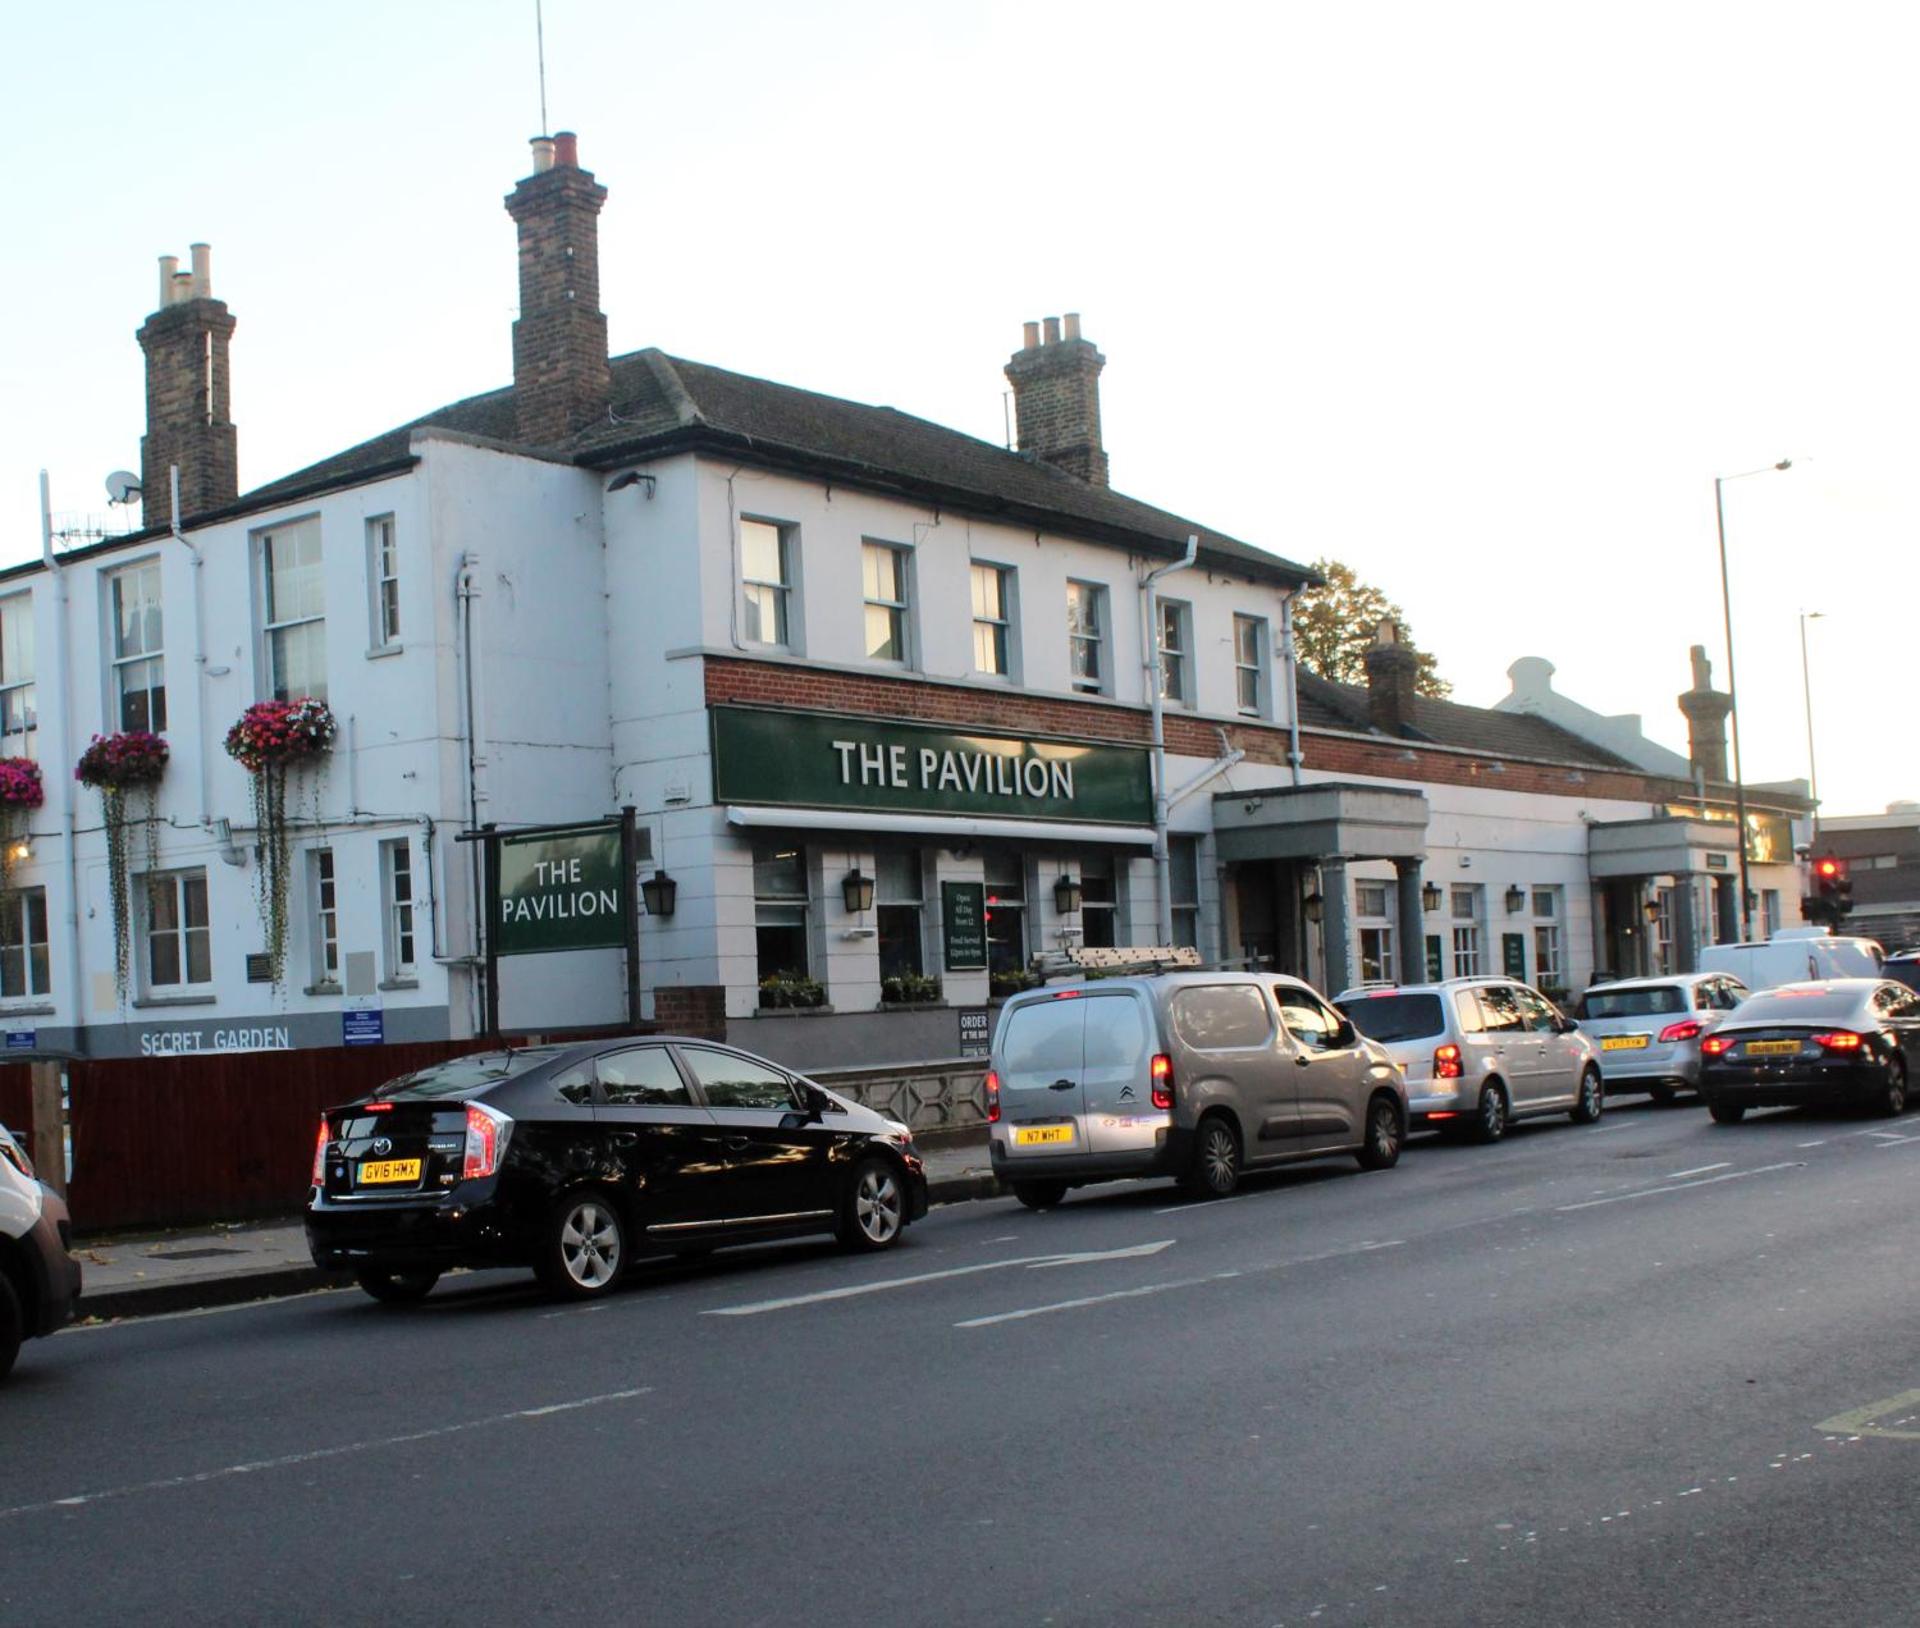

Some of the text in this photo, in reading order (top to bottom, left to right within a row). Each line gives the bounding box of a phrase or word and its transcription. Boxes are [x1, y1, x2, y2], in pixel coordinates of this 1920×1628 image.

[832, 741, 1075, 799] THE PAVILION
[533, 858, 582, 887] THE
[502, 888, 618, 923] PAVILION
[960, 1015, 987, 1028] ORDER
[140, 1027, 289, 1056] SECRET GARDEN
[1027, 1130, 1039, 1142] N7
[366, 1162, 415, 1179] GV16 HMX
